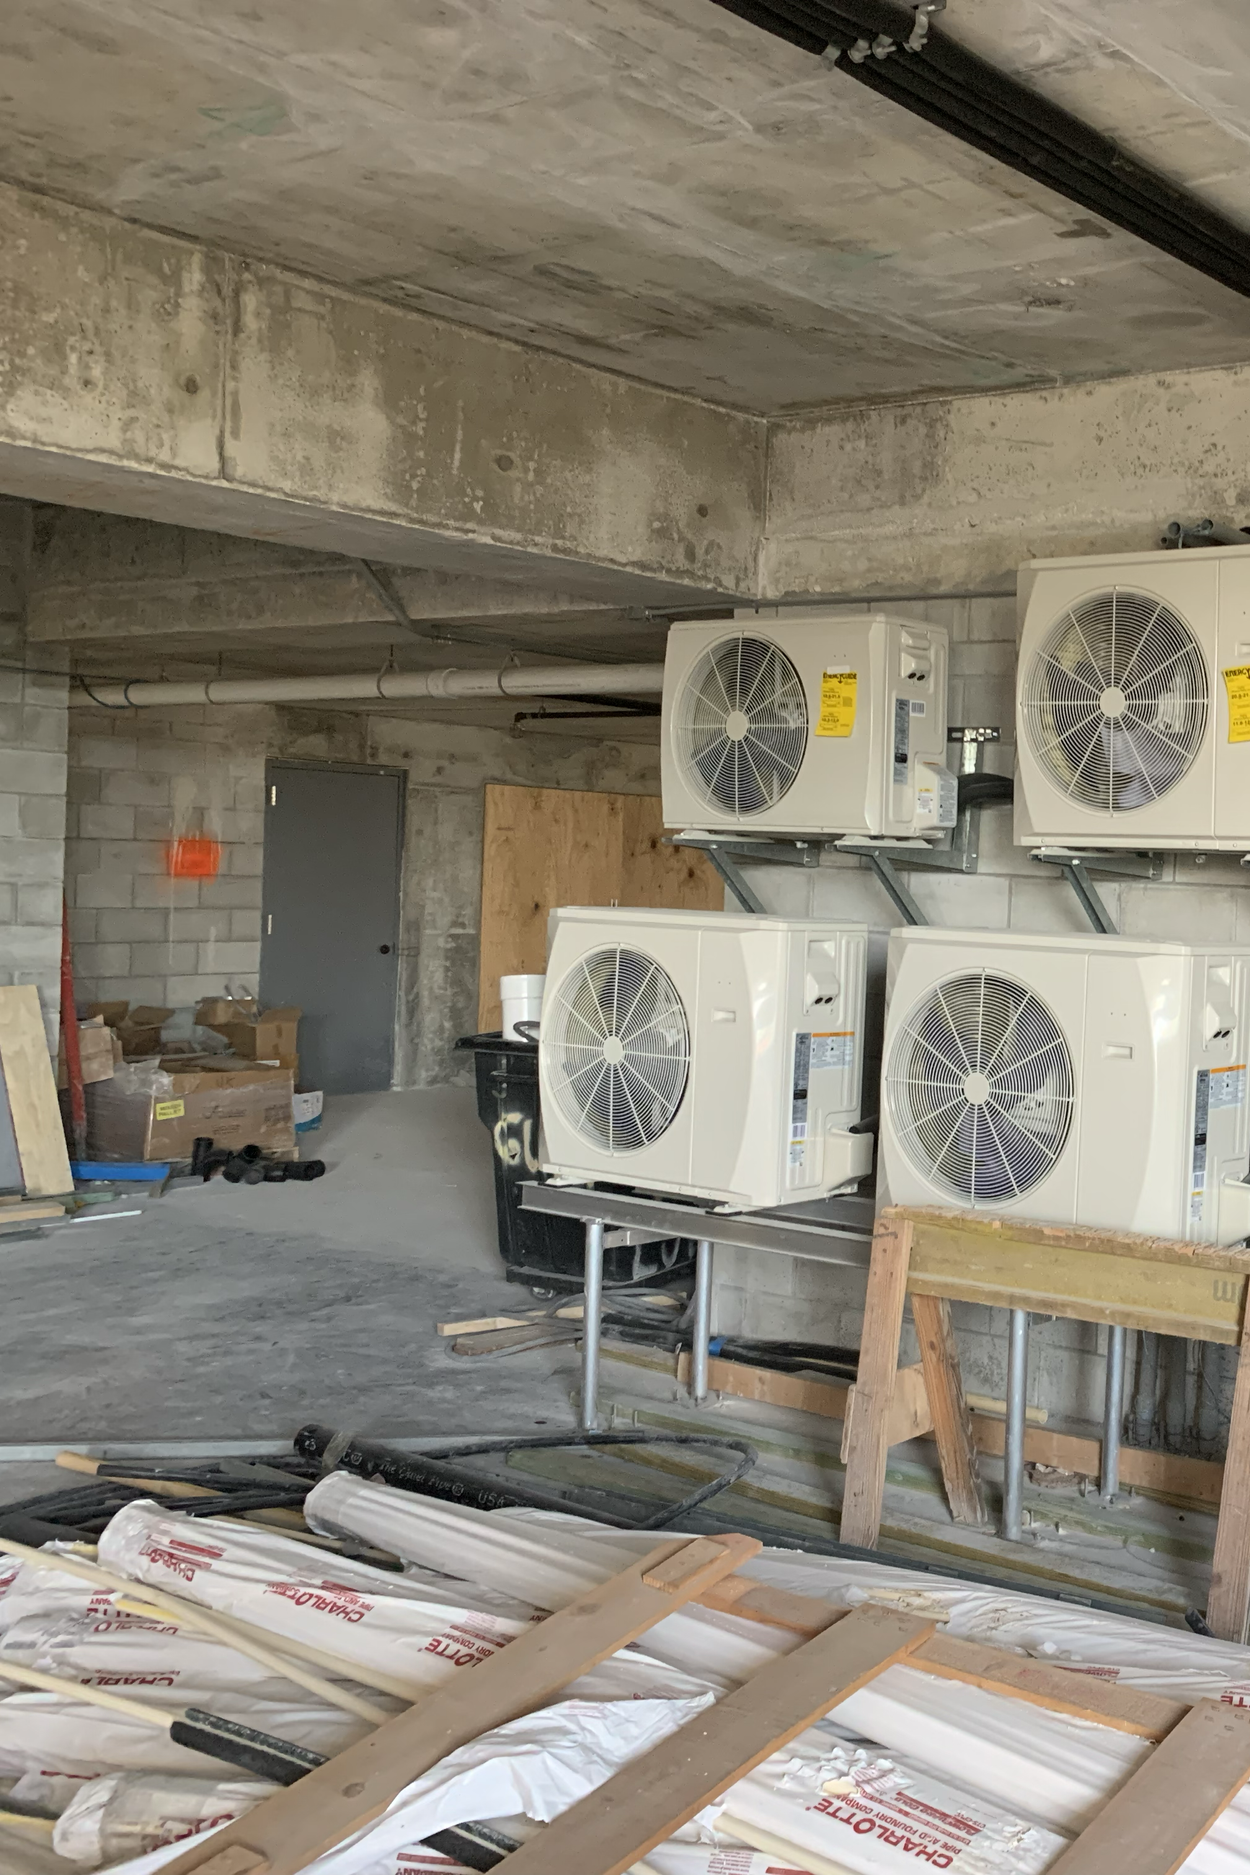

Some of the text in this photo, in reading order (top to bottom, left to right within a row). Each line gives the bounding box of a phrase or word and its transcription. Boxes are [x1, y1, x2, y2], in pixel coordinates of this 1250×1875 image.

[812, 1797, 954, 1870] CHARLOTTE
[873, 1810, 919, 1837] FOUNDRY
[939, 1840, 963, 1855] PIPE
